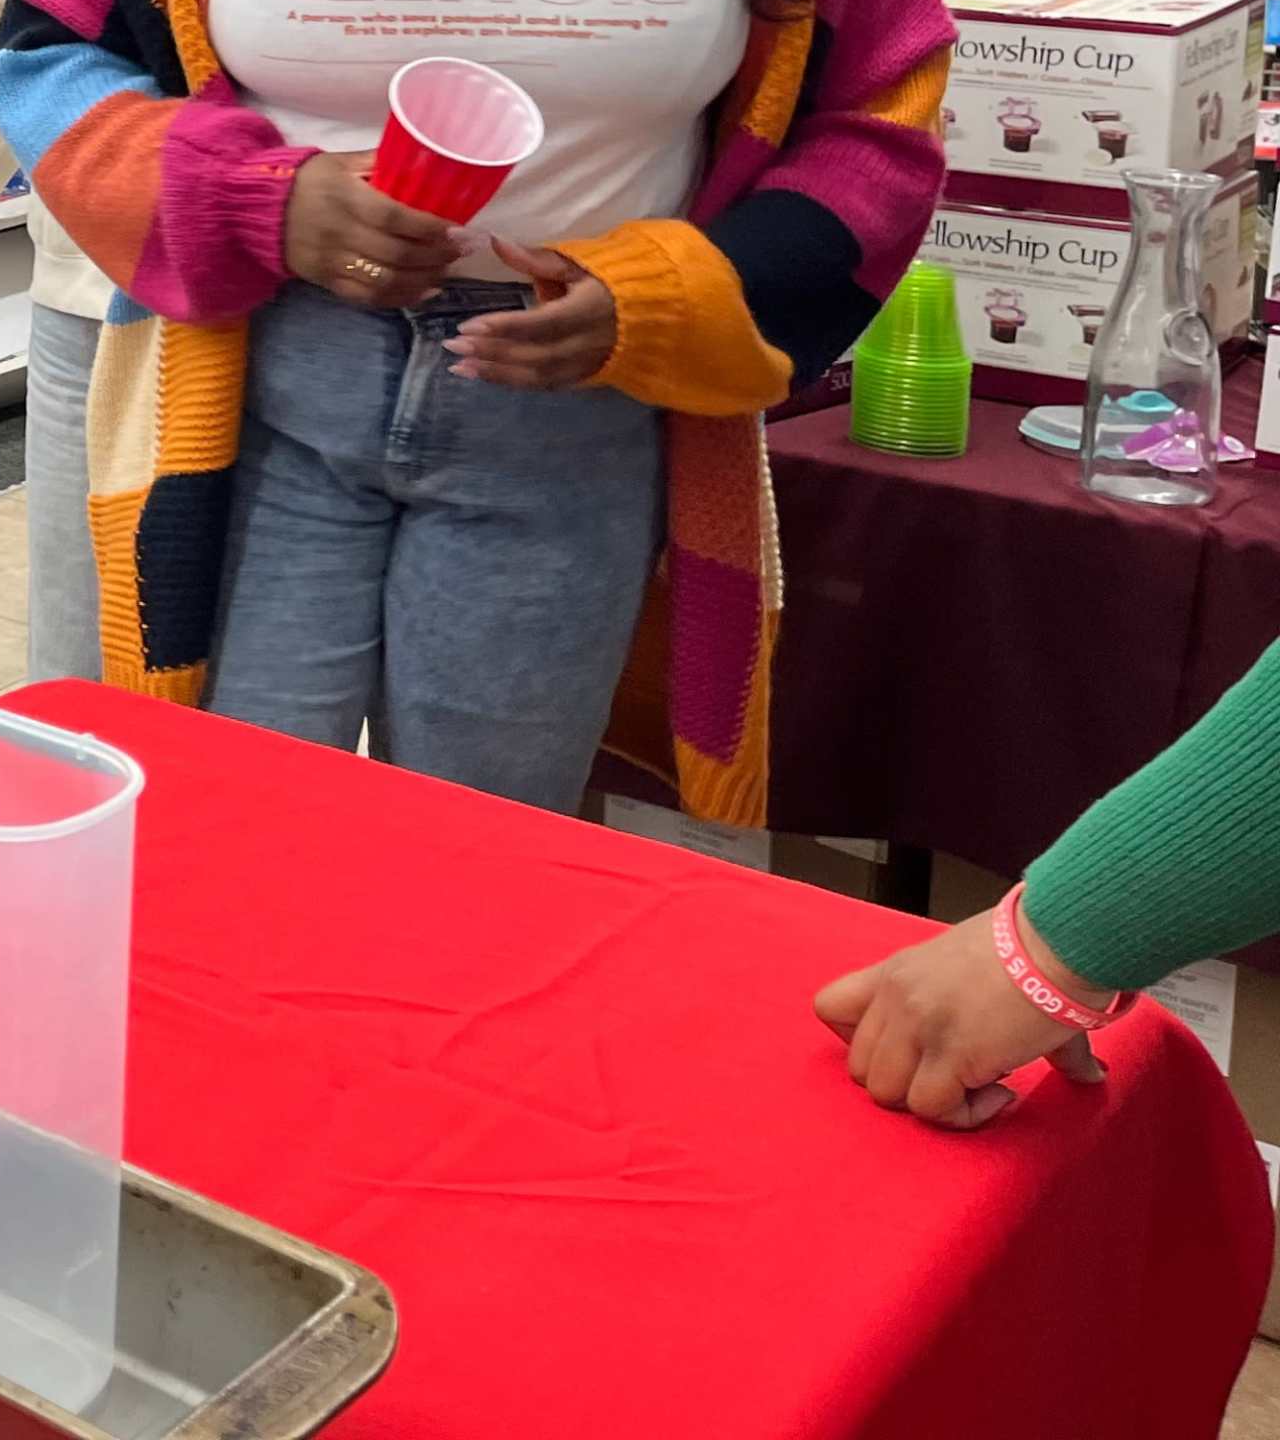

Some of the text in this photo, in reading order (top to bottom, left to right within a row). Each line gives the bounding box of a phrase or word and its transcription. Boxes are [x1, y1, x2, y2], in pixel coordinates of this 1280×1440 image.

[301, 14, 357, 24] person
[360, 12, 398, 23] who
[442, 14, 522, 25] potential
[525, 15, 561, 26] and
[564, 15, 579, 27] is
[583, 19, 642, 31] among
[644, 16, 669, 28] the
[344, 25, 376, 36] first
[380, 27, 398, 36] to
[479, 27, 503, 37] an
[954, 35, 1065, 72] lowship
[1073, 44, 1134, 78] Cup
[1058, 240, 1119, 274] Cup
[1005, 956, 1029, 980] IS
[1021, 976, 1064, 1014] GOD
